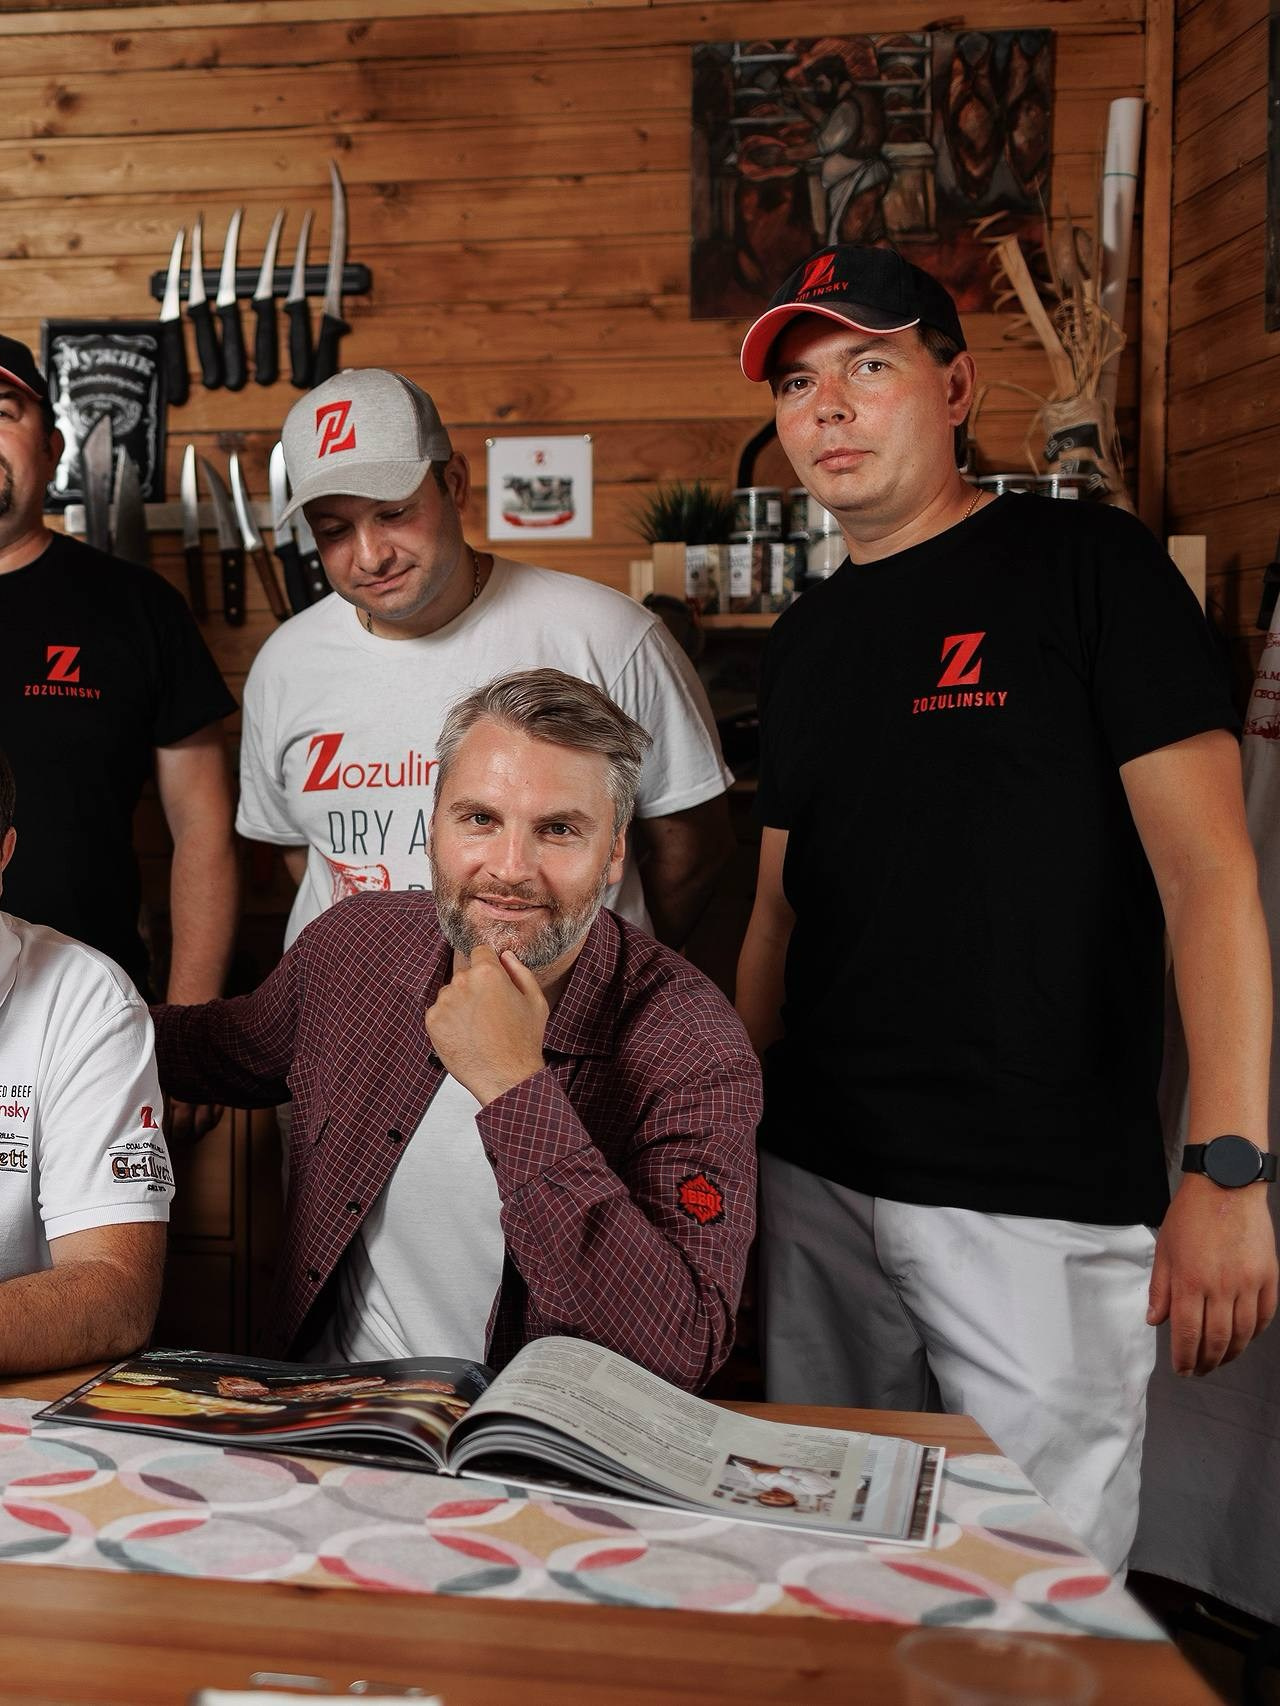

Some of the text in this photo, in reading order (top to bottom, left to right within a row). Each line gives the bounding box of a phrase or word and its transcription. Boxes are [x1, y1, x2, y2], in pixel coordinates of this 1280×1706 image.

[46, 645, 81, 683] Z
[936, 631, 987, 688] Z
[24, 684, 101, 700] ZOZULINSKY
[912, 691, 1008, 714] ZOZULINSKY
[327, 809, 394, 856] DRY
[11, 1085, 33, 1098] BEEF
